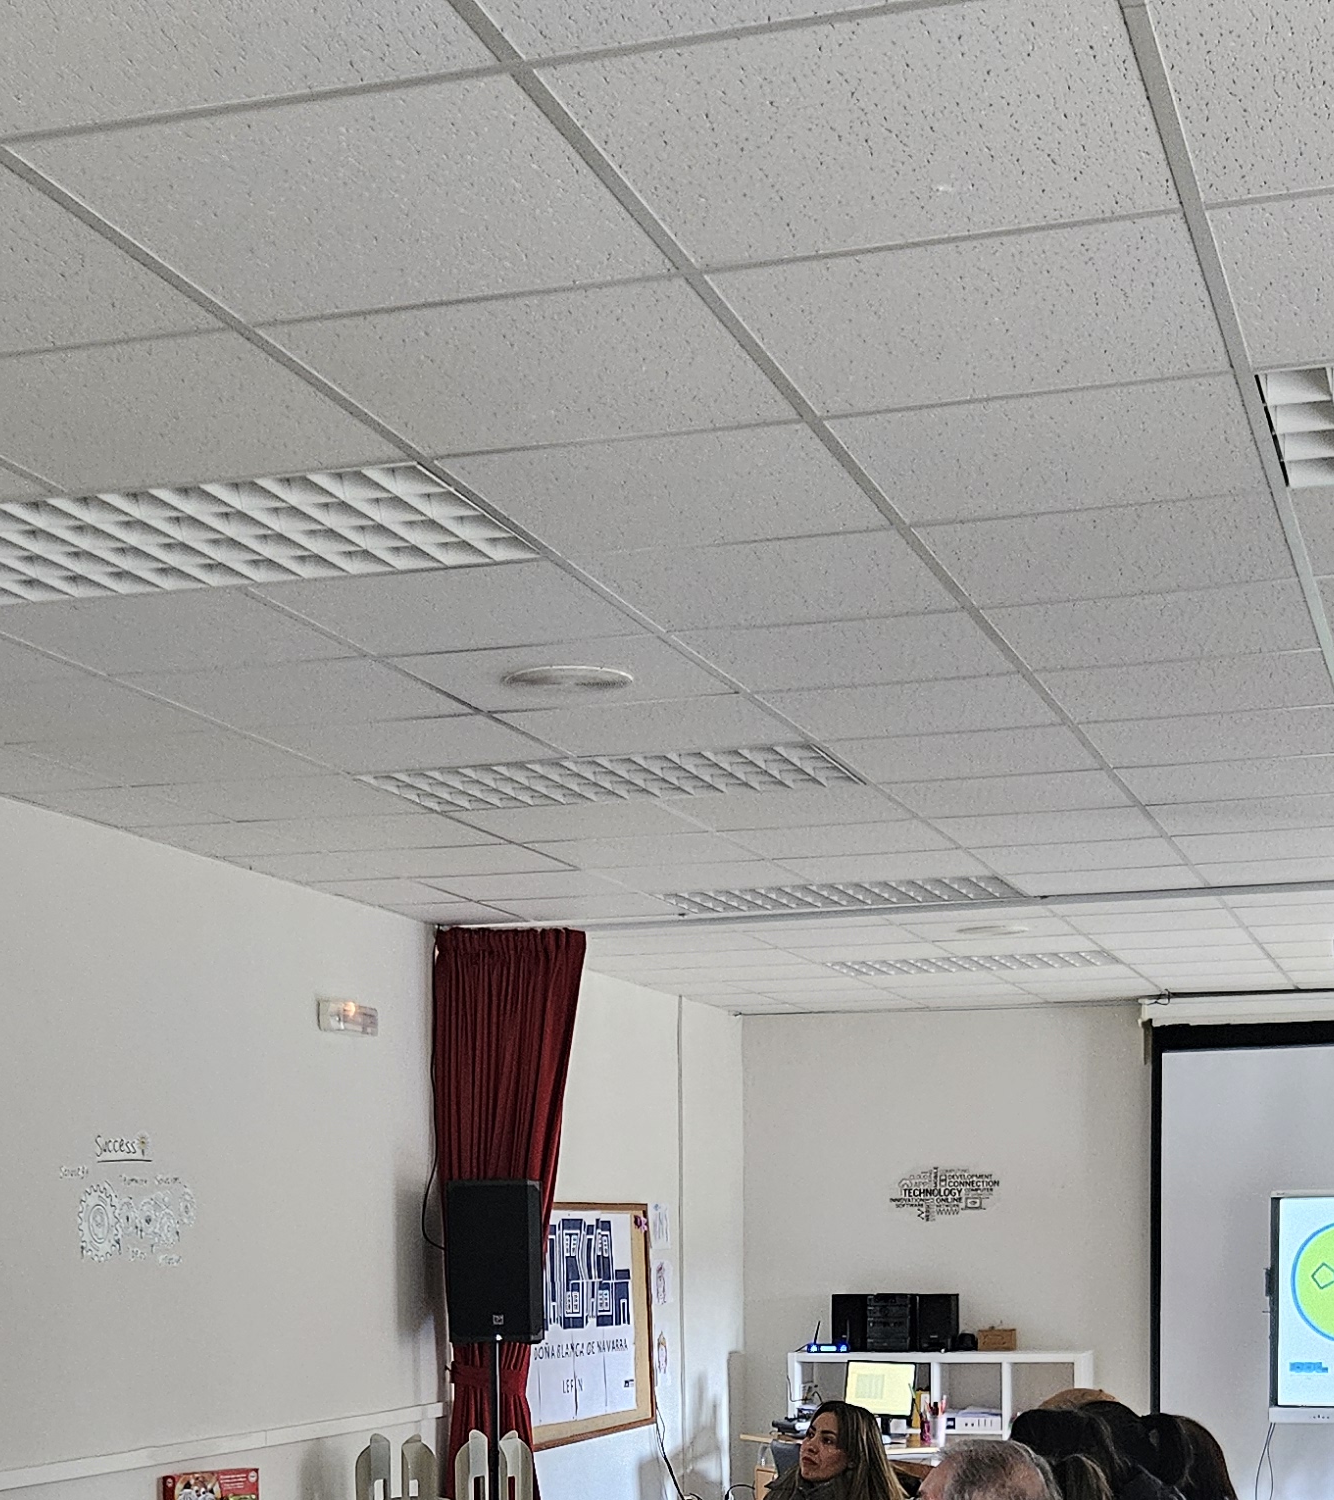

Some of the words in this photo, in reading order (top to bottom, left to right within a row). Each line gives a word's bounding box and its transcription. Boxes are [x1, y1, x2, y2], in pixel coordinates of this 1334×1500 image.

[948, 1180, 1000, 1188] CONNECTION
[902, 1188, 963, 1198] TECHNOLOGY
[534, 1342, 555, 1360] DOÑA
[556, 1342, 585, 1358] BLANCA
[586, 1341, 595, 1355] DE
[596, 1338, 629, 1353] NAVARRA
[562, 1378, 584, 1394] LERN
